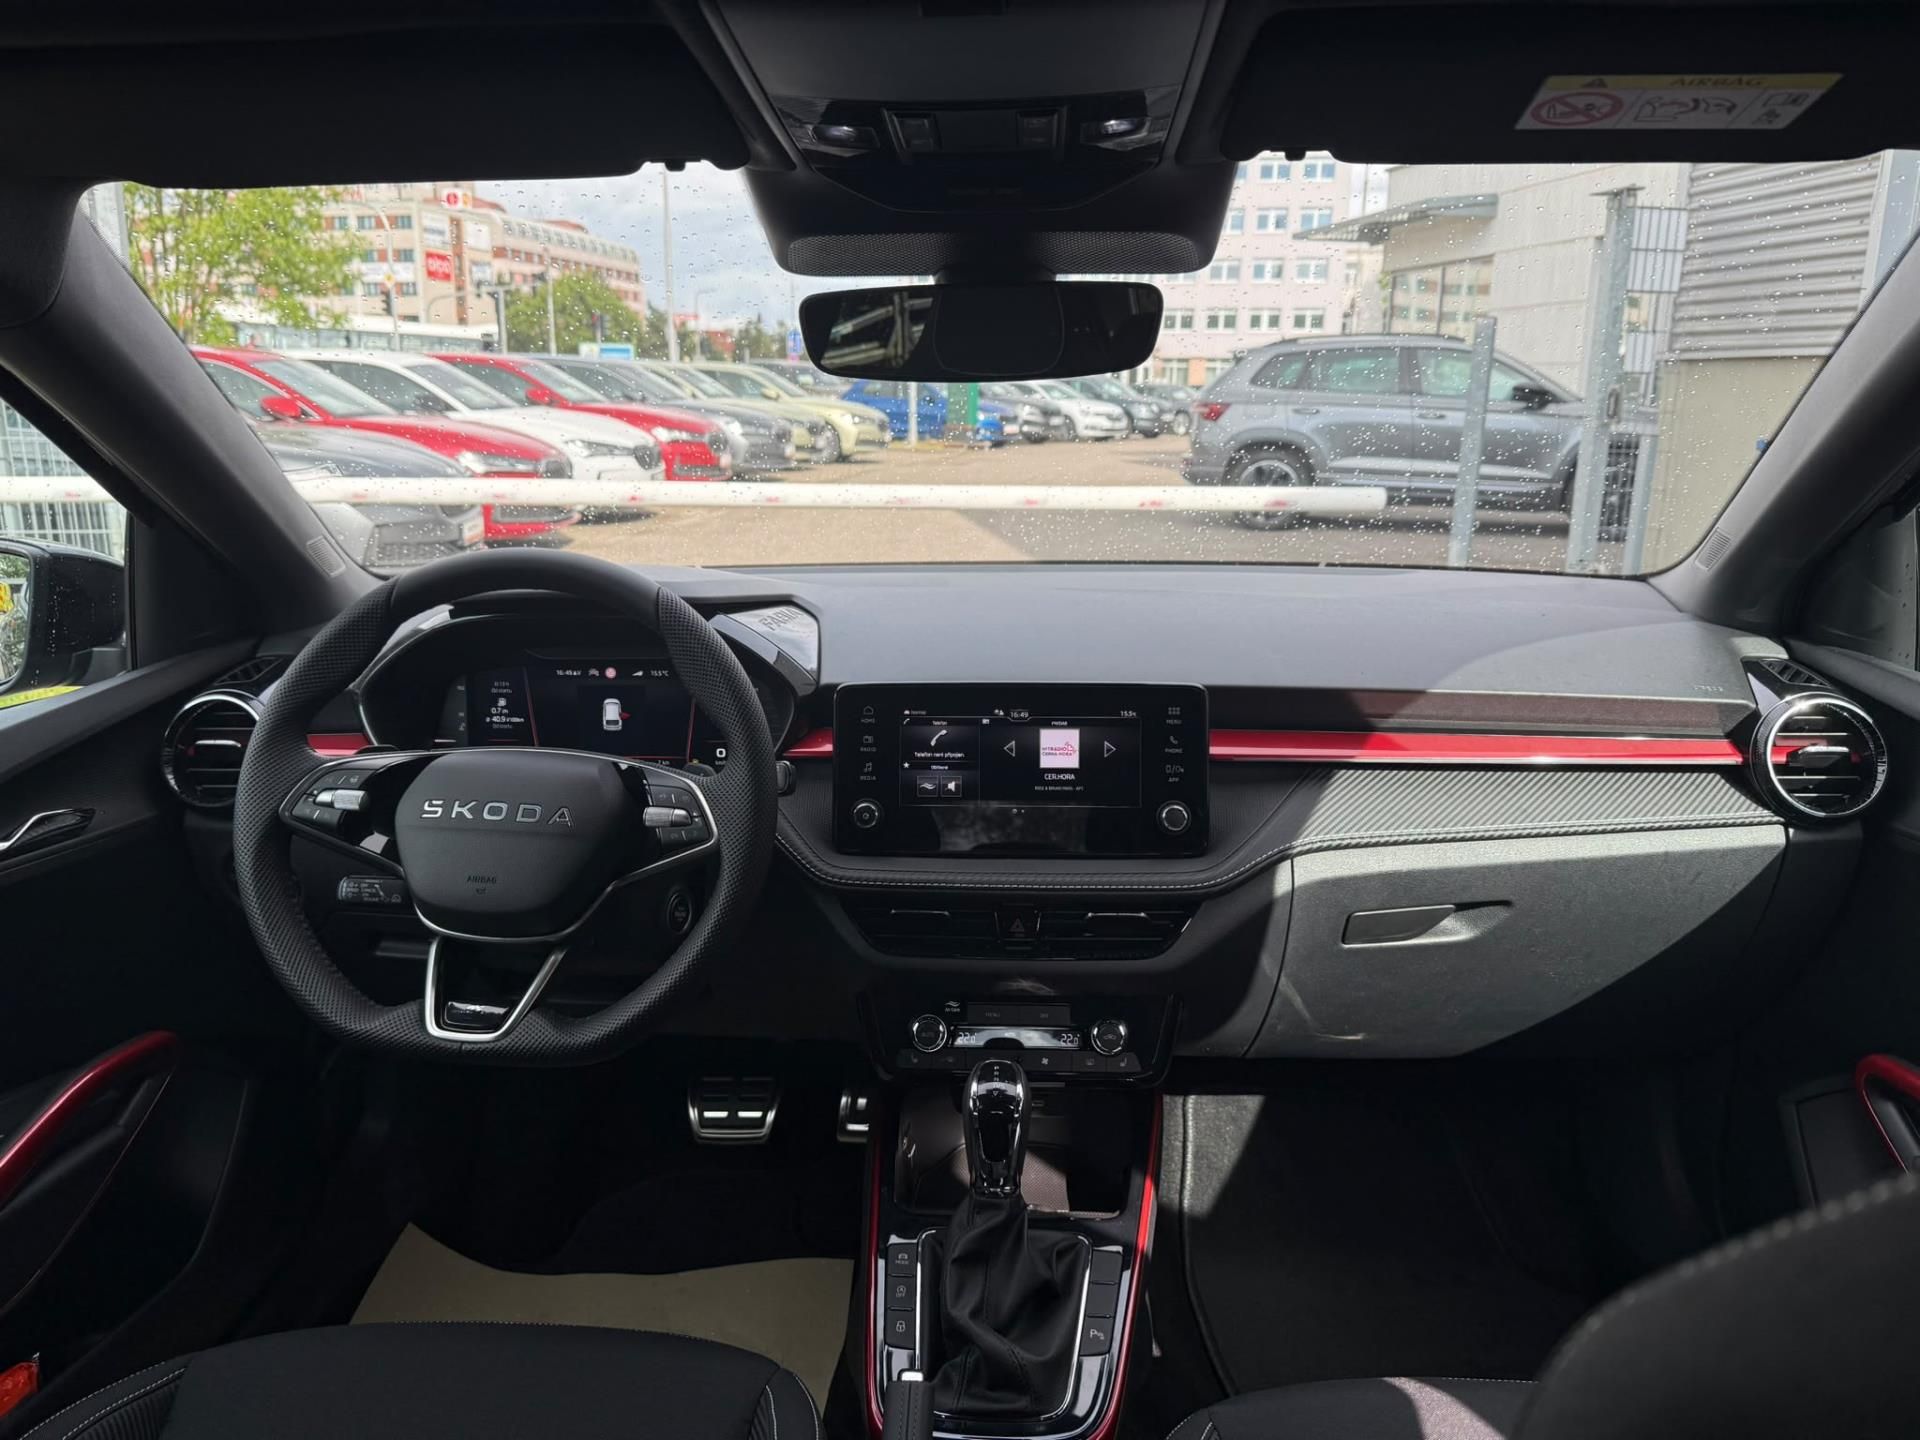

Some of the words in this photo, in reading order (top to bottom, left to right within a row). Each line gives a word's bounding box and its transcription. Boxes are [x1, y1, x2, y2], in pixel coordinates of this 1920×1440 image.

[1669, 77, 1766, 87] AIRBAG
[758, 608, 804, 632] FABIA
[715, 747, 727, 759] 0
[467, 875, 497, 885] AIRBAG
